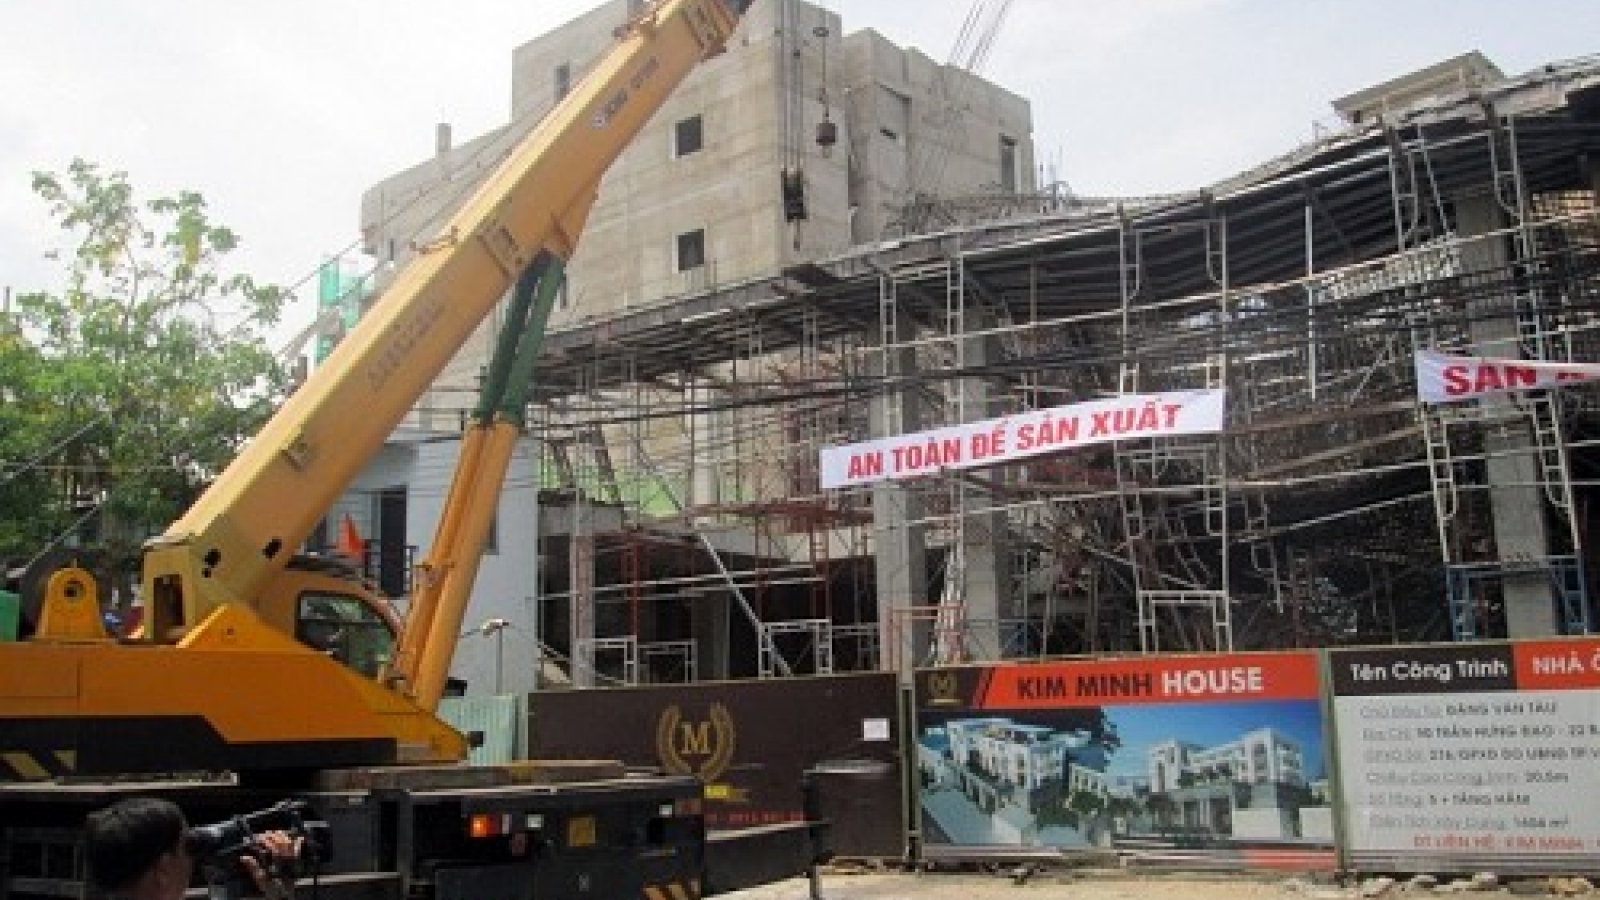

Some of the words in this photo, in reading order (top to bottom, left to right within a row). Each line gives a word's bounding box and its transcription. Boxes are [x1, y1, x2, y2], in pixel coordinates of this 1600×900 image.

[847, 450, 883, 480] AN
[889, 435, 961, 473] TOÀN
[1090, 399, 1182, 438] XUẤT
[1016, 674, 1066, 700] KIM
[1075, 672, 1153, 698] MINH
[1160, 666, 1266, 697] HOUSE
[1350, 662, 1387, 681] Tên
[1391, 661, 1451, 684] Công
[681, 720, 712, 755] M
